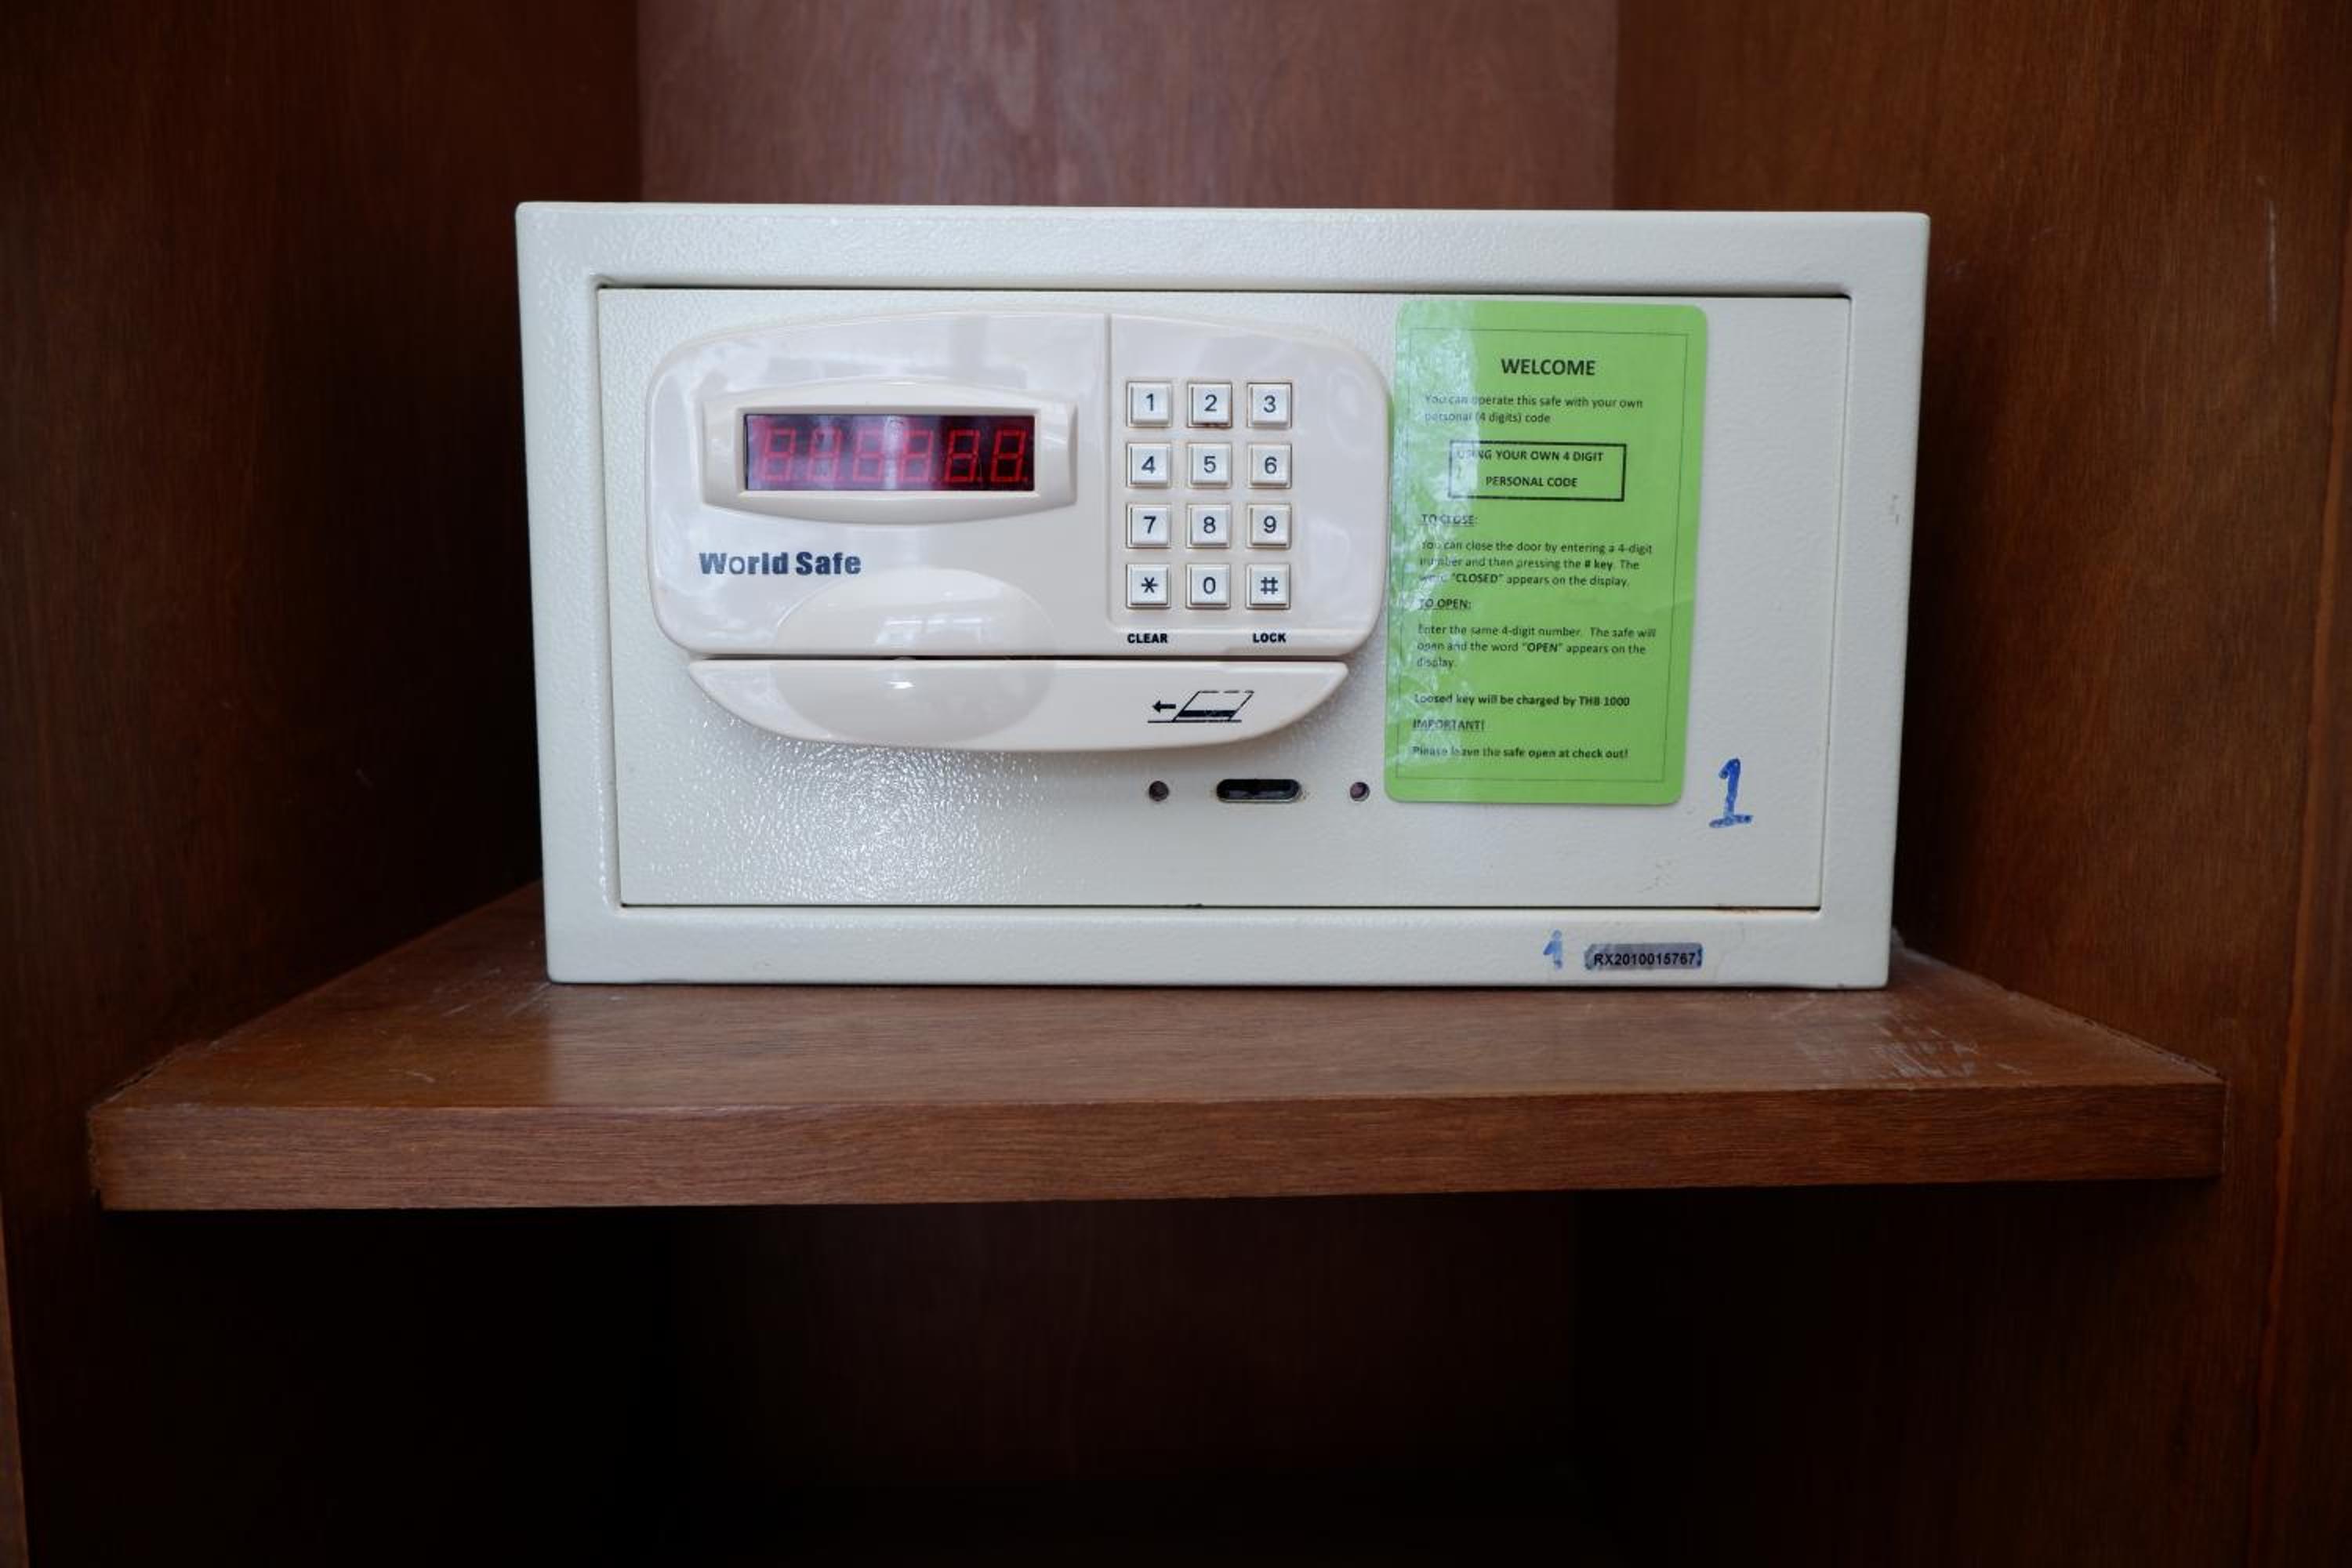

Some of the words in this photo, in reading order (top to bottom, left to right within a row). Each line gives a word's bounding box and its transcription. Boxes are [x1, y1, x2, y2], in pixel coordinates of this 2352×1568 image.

[1501, 358, 1595, 376] WELCOME
[1145, 394, 1155, 411] 1
[1204, 394, 1218, 412] 2
[1264, 395, 1276, 412] 3
[1518, 395, 1537, 405] this
[1540, 395, 1561, 406] safe
[1565, 397, 1588, 407] with
[1592, 399, 1616, 408] your
[1489, 412, 1521, 423] digits)
[1525, 414, 1551, 423] code
[1496, 450, 1526, 459] YOUR
[1530, 451, 1559, 460] OWN
[1563, 452, 1570, 460] 4
[1573, 452, 1604, 461] DIGIT
[1141, 456, 1156, 474] 4
[1203, 456, 1216, 473] 5
[1265, 457, 1278, 474] 6
[1486, 477, 1544, 487] PERSONAL
[1548, 477, 1577, 487] CODE
[1144, 516, 1156, 533] 7
[1203, 516, 1216, 534] 8
[1264, 516, 1276, 534] 9
[1421, 514, 1437, 524] TO
[1443, 541, 1461, 550] can
[1466, 541, 1492, 550] close
[1496, 541, 1513, 550] the
[1516, 542, 1541, 551] door
[1545, 543, 1557, 553] by
[1561, 543, 1606, 554] entering
[699, 552, 789, 575] World
[796, 552, 862, 575] Safe
[1466, 557, 1486, 566] and
[1490, 557, 1512, 566] then
[1516, 559, 1560, 571] pressing
[1563, 559, 1581, 568] the
[1584, 560, 1591, 568] #
[1620, 560, 1639, 569] The
[1203, 576, 1216, 594] 0
[1261, 576, 1279, 594] #
[1507, 575, 1549, 586] appears
[1552, 576, 1565, 585] on
[1570, 575, 1587, 585] the
[1420, 598, 1433, 608] TO
[1437, 598, 1472, 609] OPEN:
[1417, 624, 1446, 633] Enter
[1450, 625, 1467, 634] the
[1502, 626, 1534, 637] 4-digit
[1590, 627, 1609, 637] The
[1612, 628, 1635, 637] safe
[1638, 629, 1656, 637] will
[1127, 633, 1168, 644] CLEAR
[1253, 633, 1287, 644] LOCK
[1417, 643, 1444, 652] open
[1447, 641, 1467, 651] and
[1470, 641, 1487, 652] the
[1491, 642, 1519, 652] word
[1566, 645, 1607, 655] appears
[1628, 644, 1646, 654] the
[1414, 693, 1453, 703] Loosed
[1456, 695, 1475, 706] key
[1478, 694, 1497, 704] will
[1501, 695, 1513, 704] be
[1515, 695, 1559, 706] charged
[1563, 696, 1576, 706] by
[1579, 696, 1600, 706] THB
[1603, 696, 1630, 706] 1000
[1413, 719, 1484, 731] IMPORTANT!
[1411, 746, 1447, 756] Please
[1450, 746, 1479, 757] leave
[1483, 747, 1501, 757] the
[1503, 748, 1525, 757] safe
[1528, 750, 1555, 760] open
[1558, 750, 1570, 758] at
[1572, 748, 1603, 758] check
[1605, 749, 1628, 759] out!
[1708, 758, 1753, 828] 1
